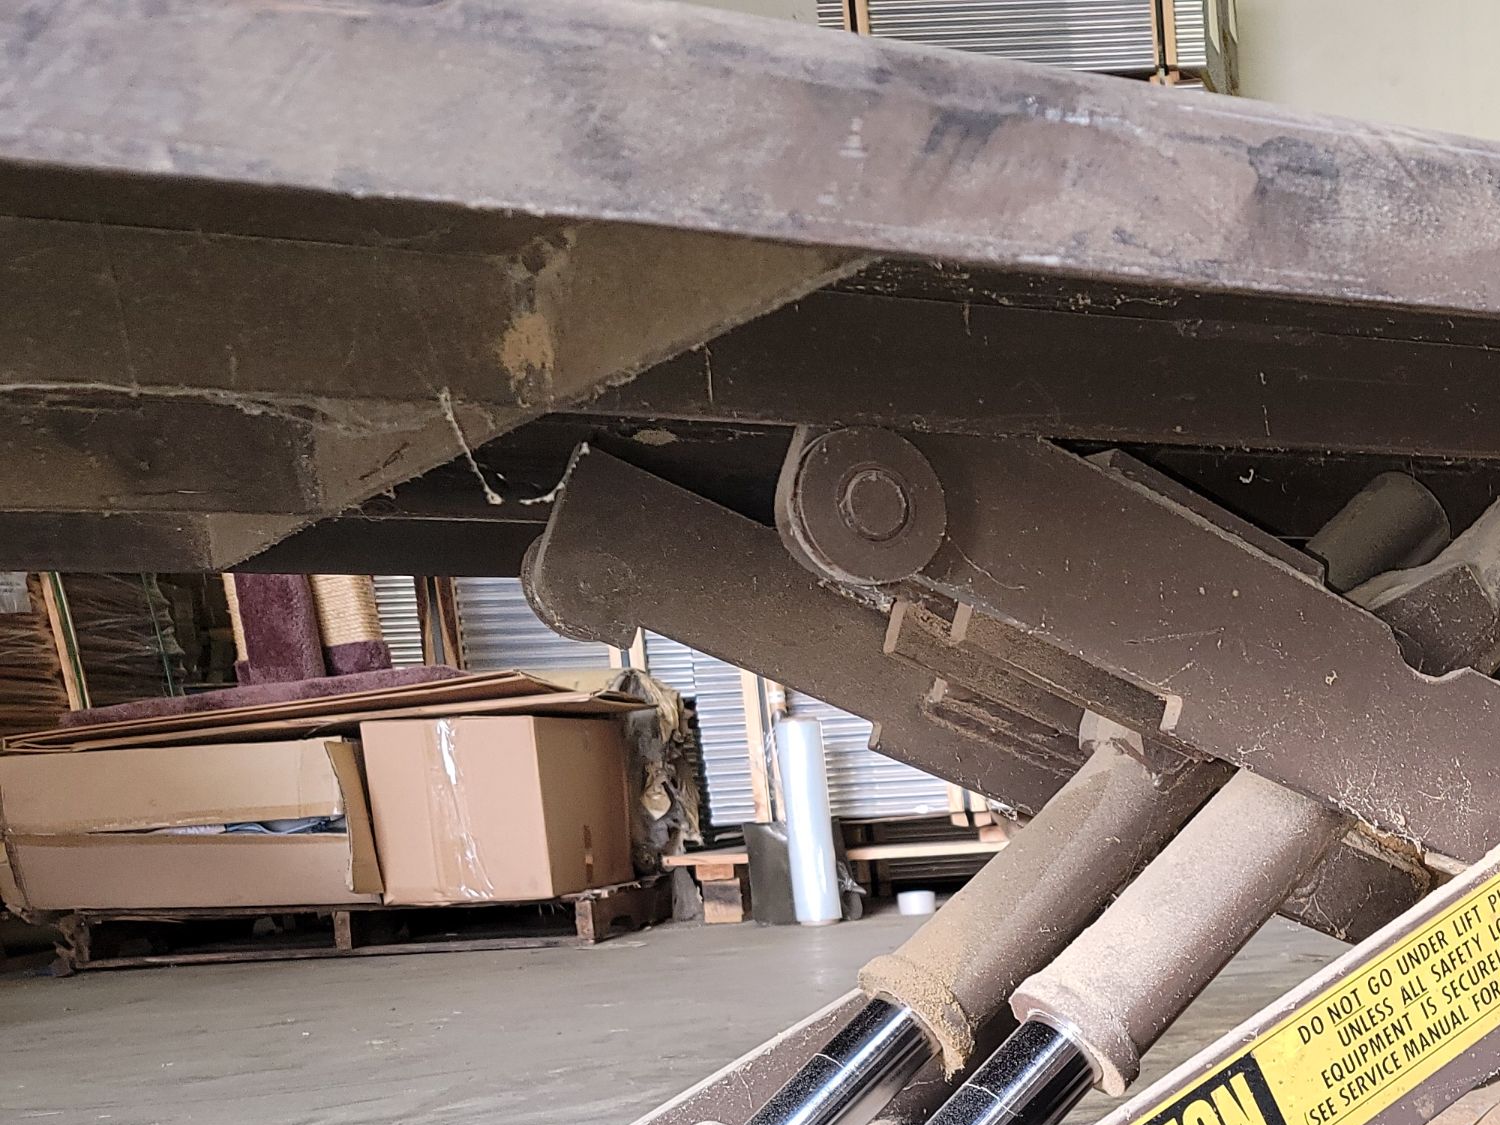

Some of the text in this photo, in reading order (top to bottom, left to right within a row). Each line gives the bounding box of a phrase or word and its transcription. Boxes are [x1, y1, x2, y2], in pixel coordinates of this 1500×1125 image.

[1297, 1015, 1324, 1045] DO
[1327, 987, 1364, 1023] NOT
[1368, 968, 1393, 995] GO
[1396, 930, 1449, 975] UNDER
[1452, 905, 1482, 937] LIFT
[1336, 1000, 1394, 1047] UNLESS
[1400, 975, 1429, 1006] ALL
[1431, 938, 1483, 982] SAFETY
[1321, 1013, 1413, 1089] EQUIPMENT
[1421, 999, 1437, 1020] IS
[1339, 1060, 1402, 1107] SERVICE
[1403, 1010, 1469, 1062] MANUAL
